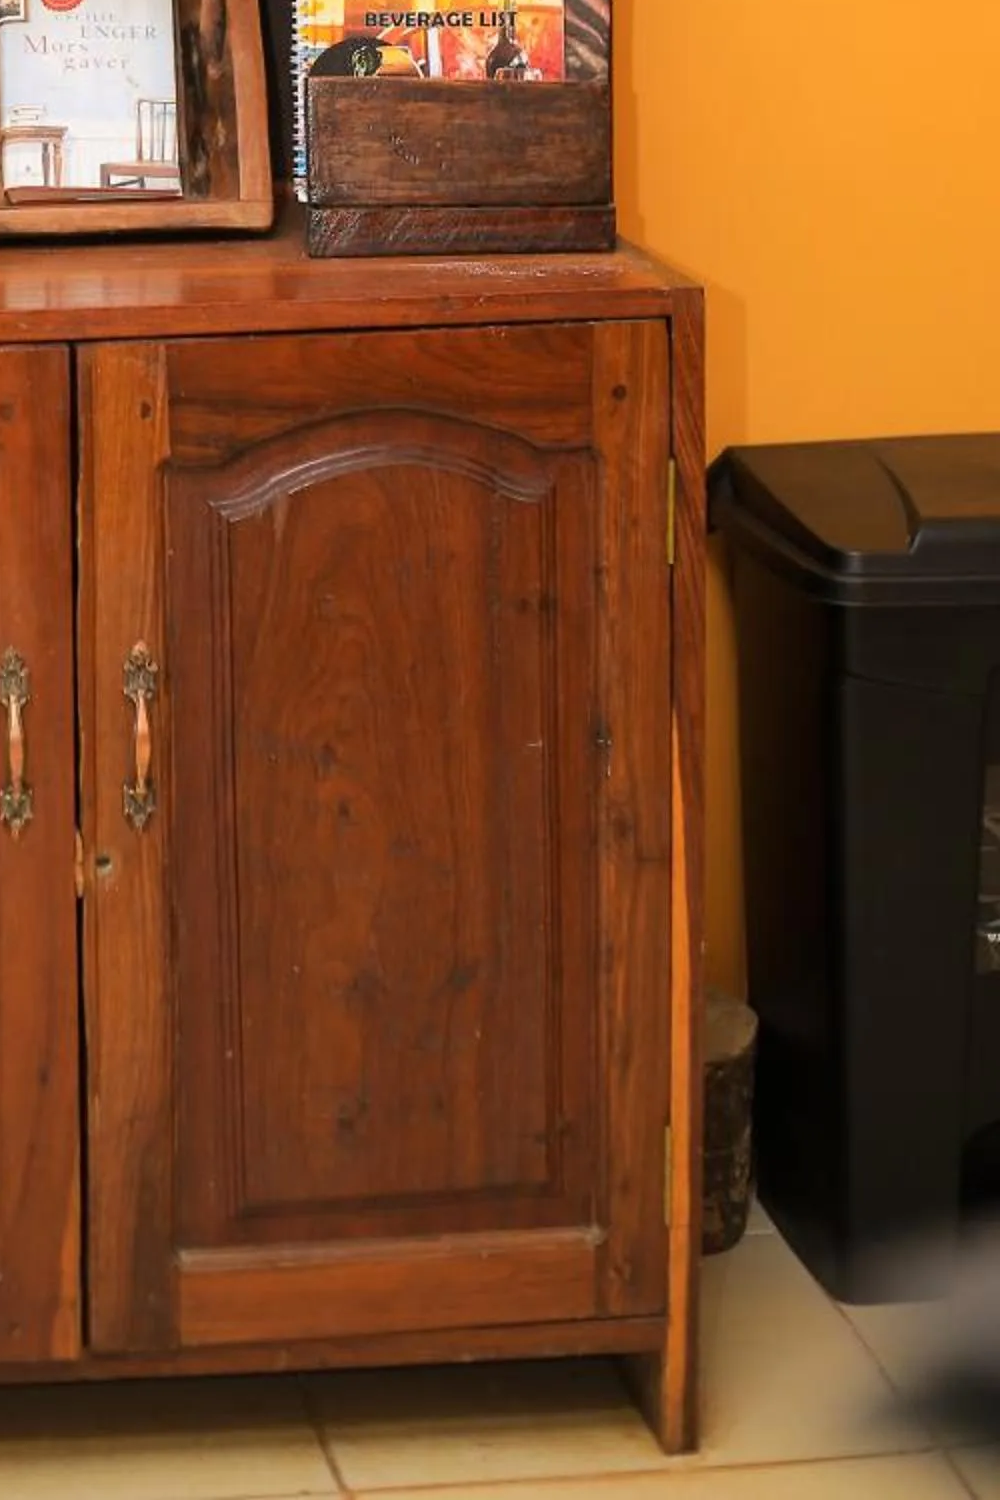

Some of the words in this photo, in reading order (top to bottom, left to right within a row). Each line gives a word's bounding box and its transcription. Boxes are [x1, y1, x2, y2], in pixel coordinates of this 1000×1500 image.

[365, 12, 473, 27] BEVERAGE
[480, 11, 518, 27] LIST
[24, 34, 89, 53] Mors
[64, 57, 128, 73] gaver
